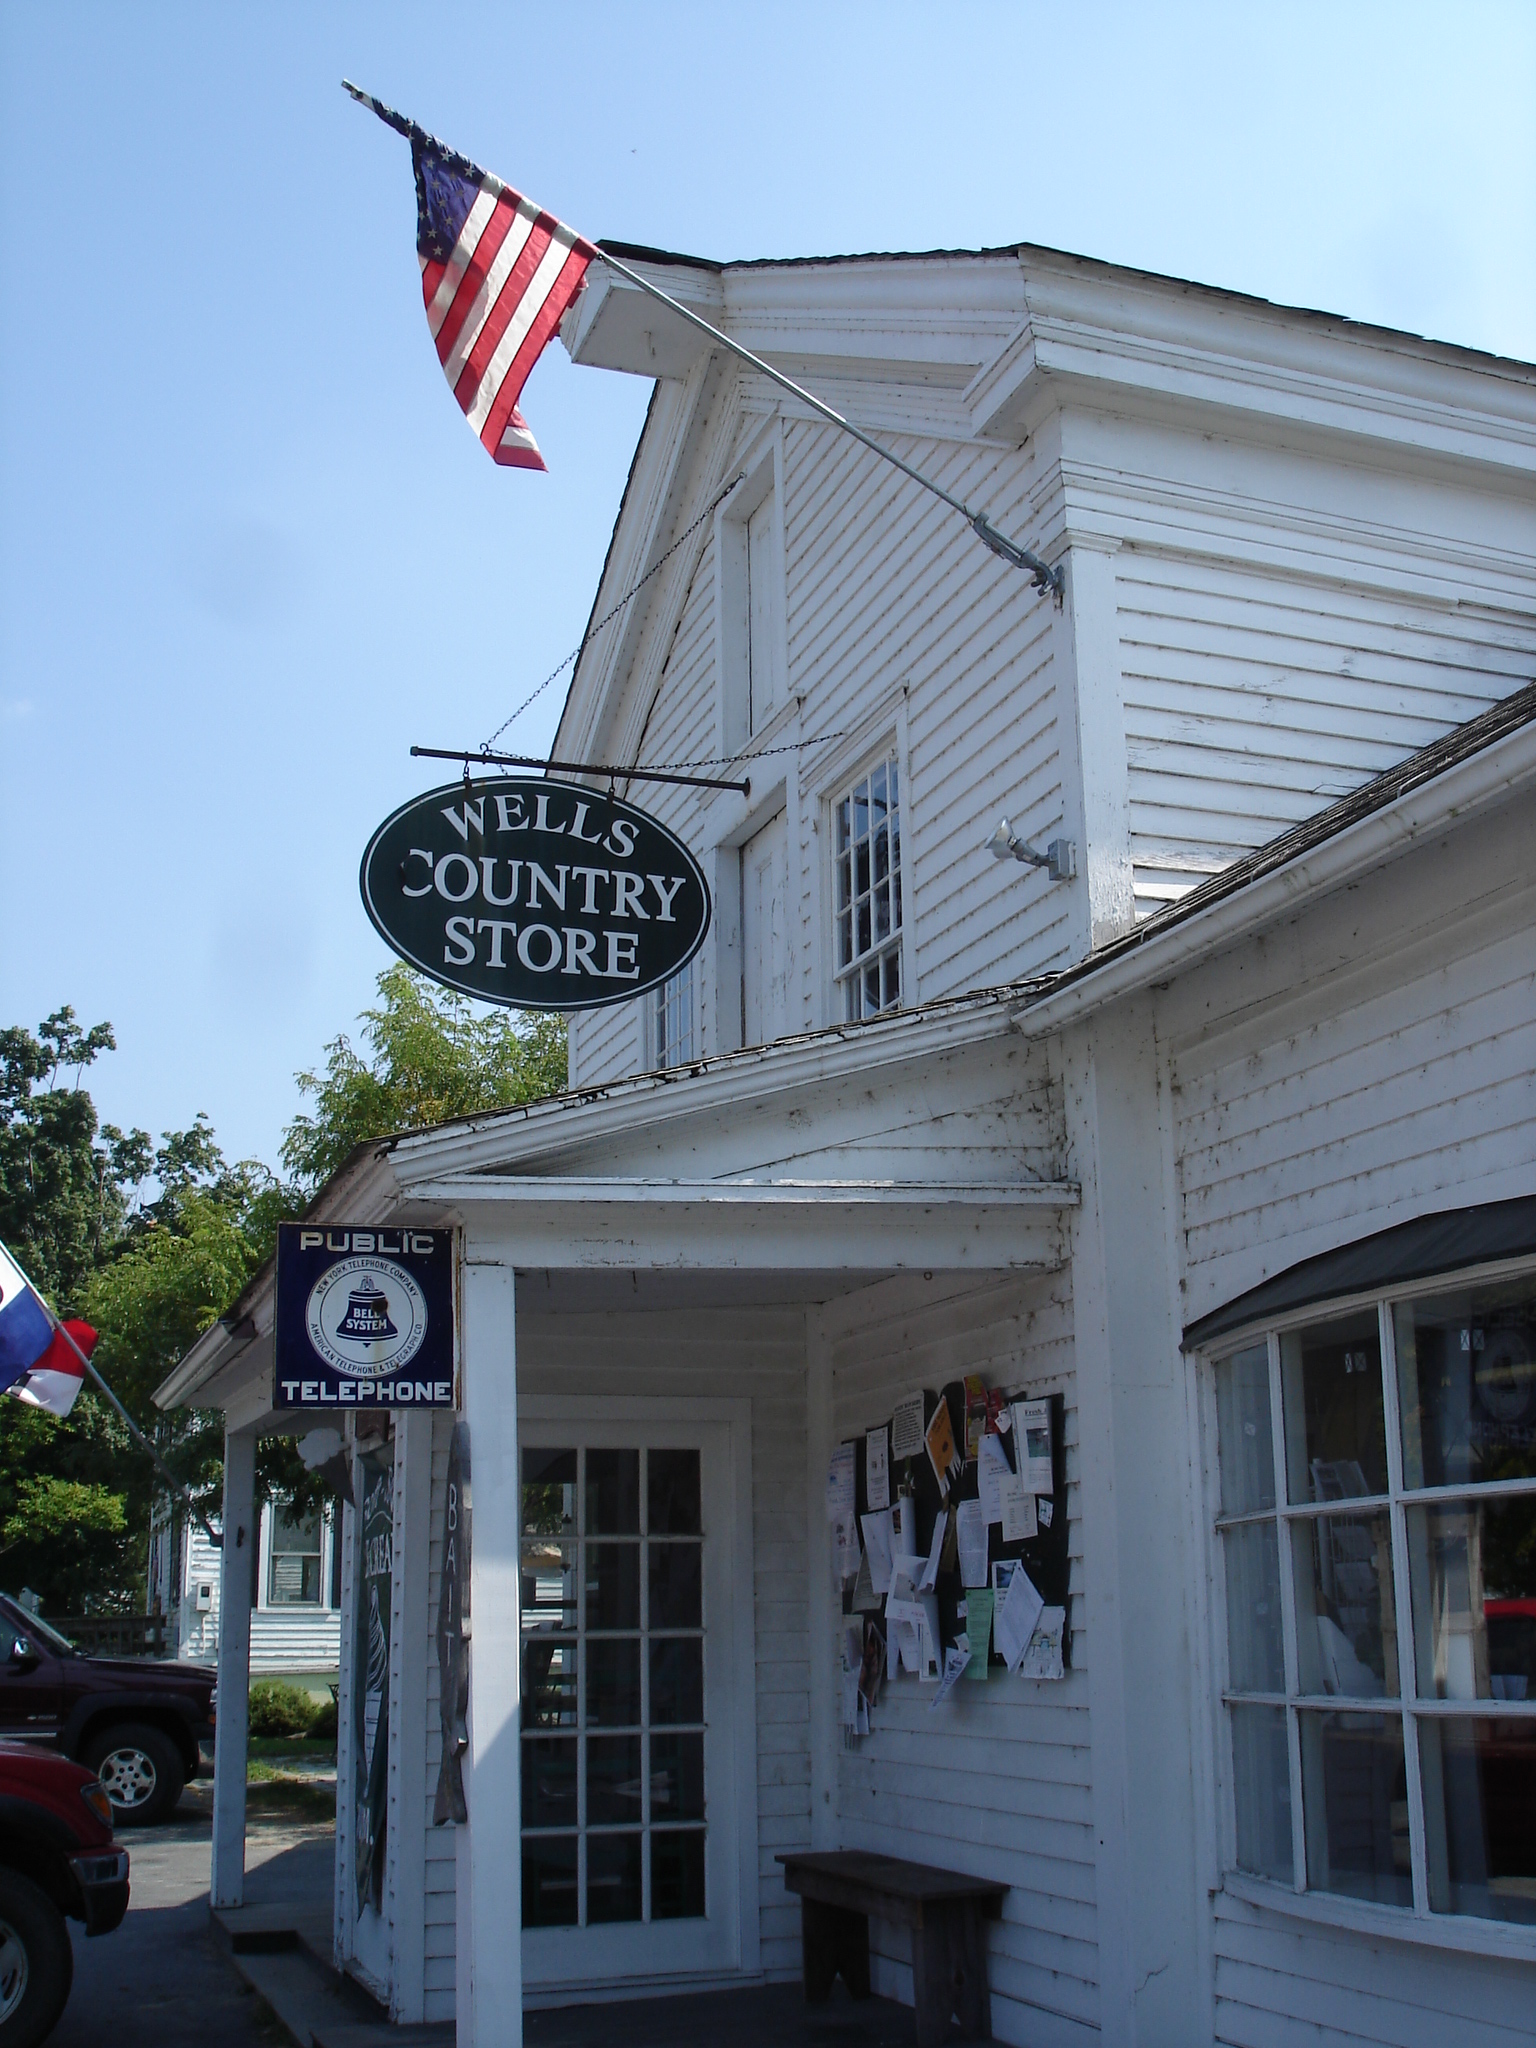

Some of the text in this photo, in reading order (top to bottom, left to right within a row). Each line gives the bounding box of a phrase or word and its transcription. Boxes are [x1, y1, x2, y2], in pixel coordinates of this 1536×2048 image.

[440, 794, 640, 858] WELLS
[401, 848, 687, 922] COUNTRY
[444, 915, 640, 980] STORE
[300, 1231, 434, 1254] PUBLIC
[315, 1259, 419, 1297] NEW YORK TELEPHONE COMPANY
[346, 1318, 388, 1331] SYSTEM
[353, 1307, 381, 1319] BELL
[311, 1323, 335, 1361] AMERICAN
[335, 1357, 378, 1374] TELEPHONE
[385, 1334, 419, 1369] TELEGRAPH
[281, 1380, 452, 1402] TELEPHONE
[445, 1483, 458, 1667] BAIT
